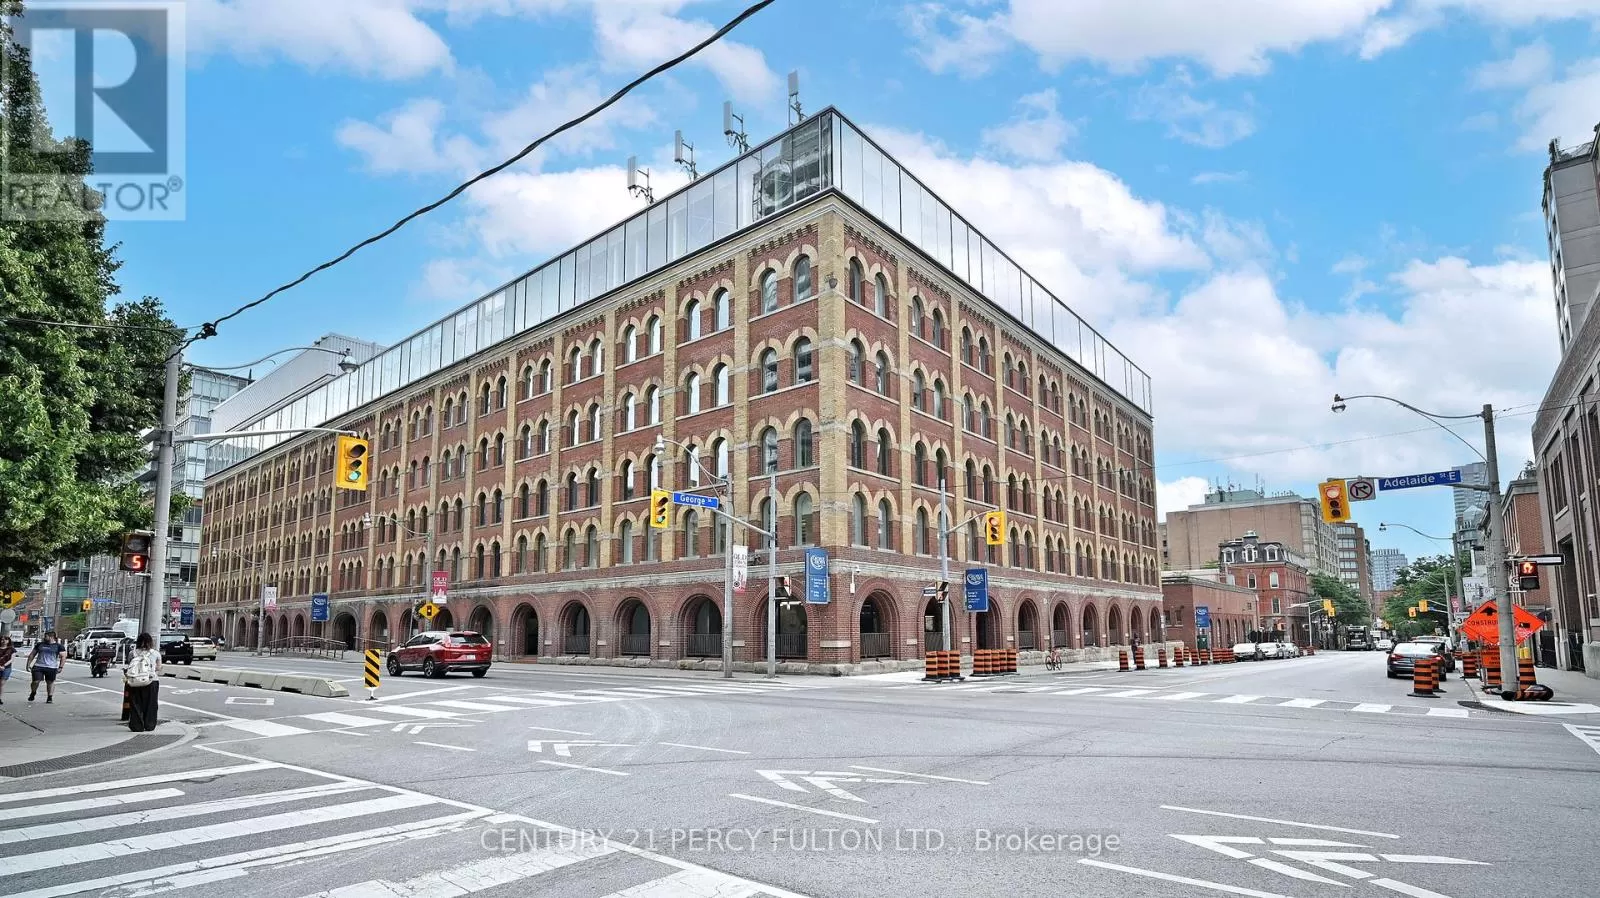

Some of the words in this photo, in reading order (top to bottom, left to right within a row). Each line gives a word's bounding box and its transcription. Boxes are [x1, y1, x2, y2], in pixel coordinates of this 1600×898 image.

[1383, 475, 1435, 488] Adelaide
[1449, 471, 1456, 481] E
[680, 494, 706, 506] George
[132, 555, 141, 569] 5
